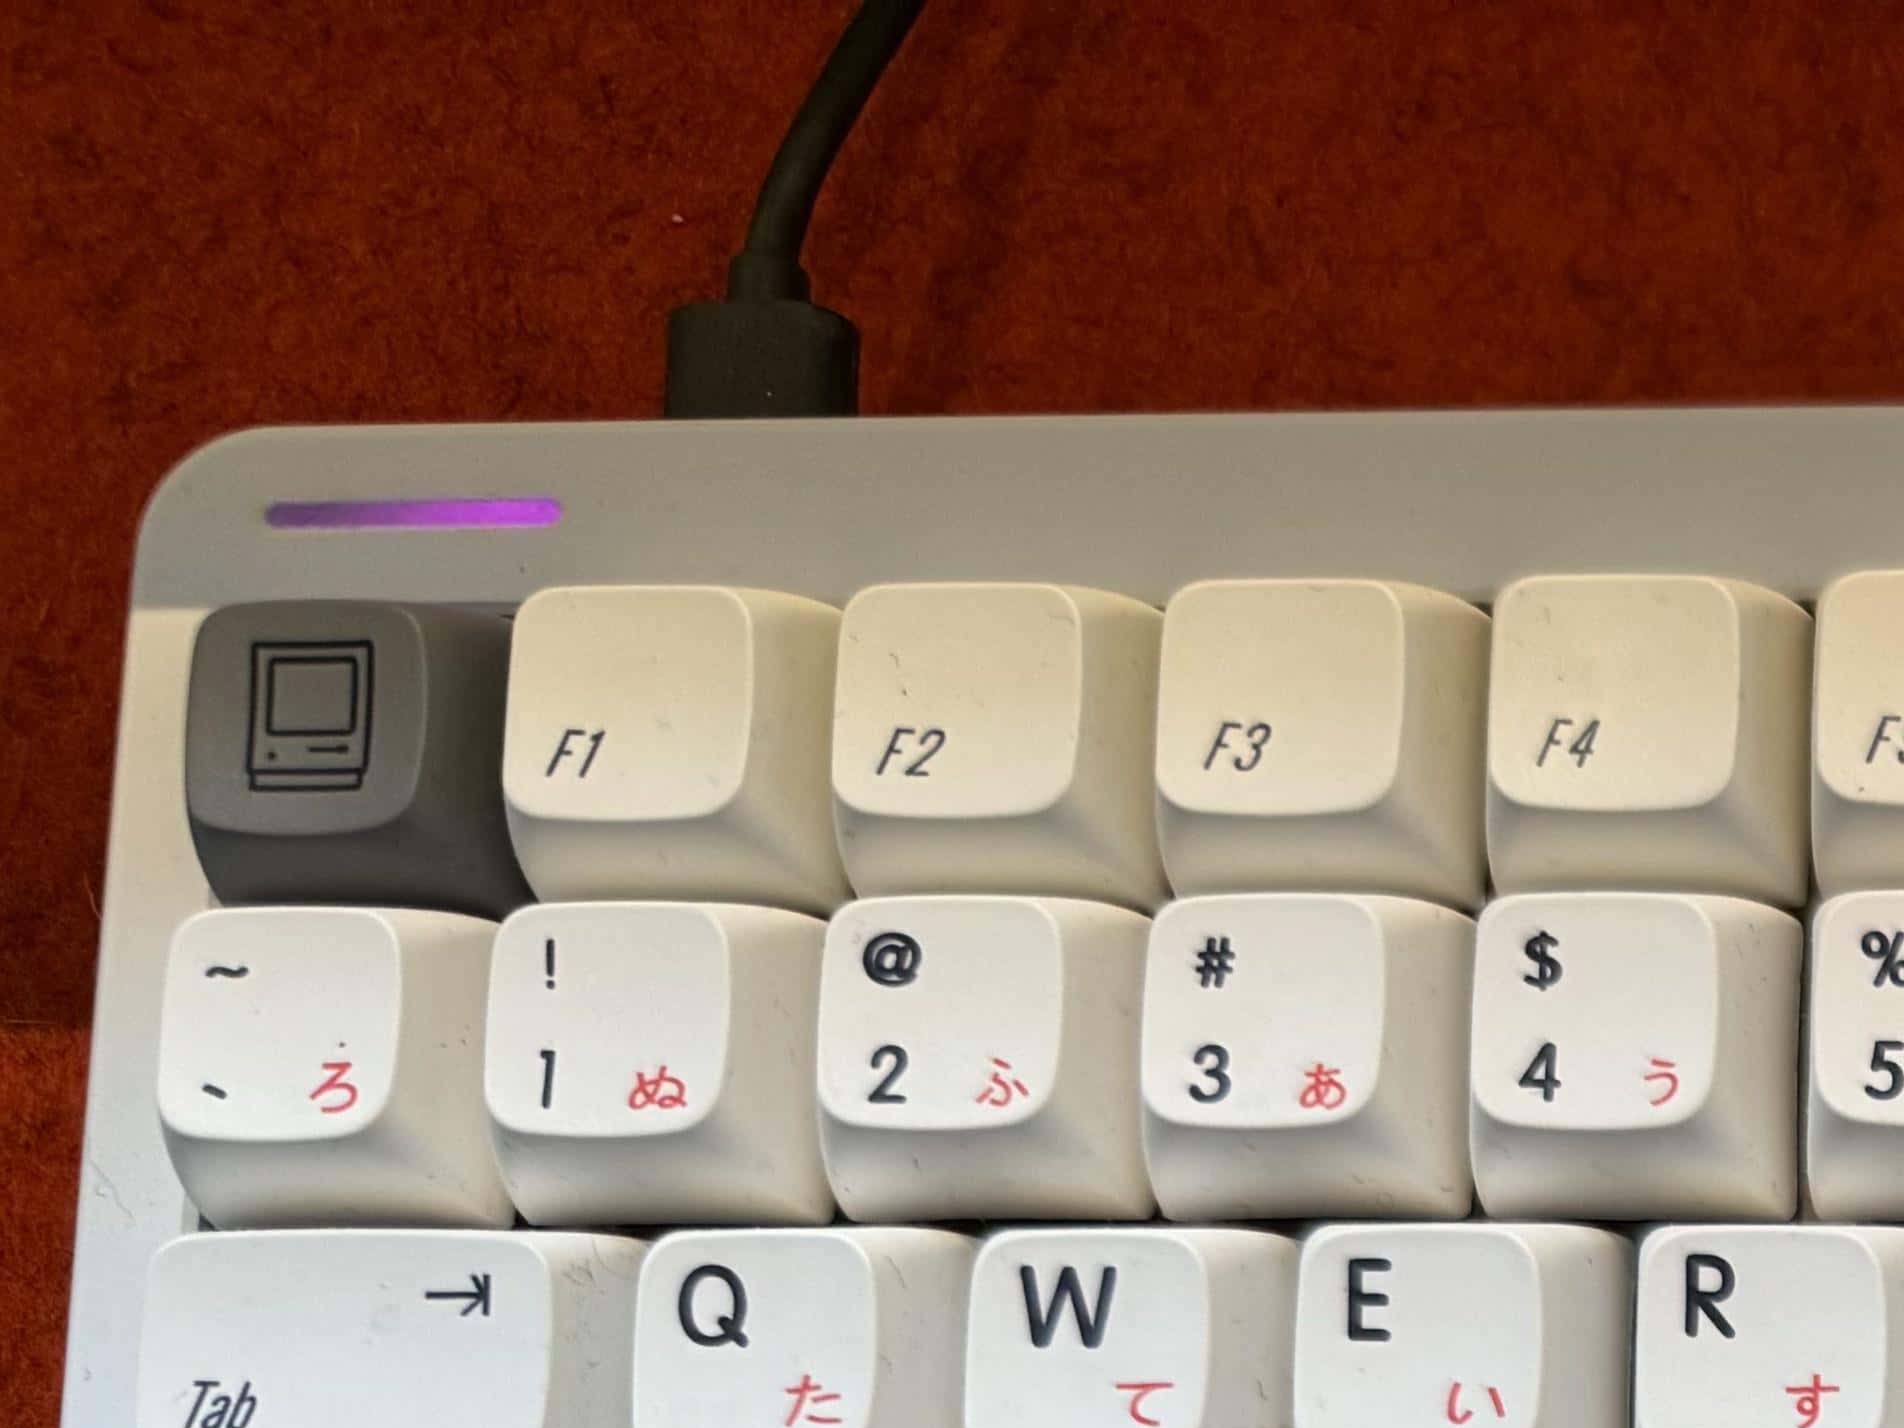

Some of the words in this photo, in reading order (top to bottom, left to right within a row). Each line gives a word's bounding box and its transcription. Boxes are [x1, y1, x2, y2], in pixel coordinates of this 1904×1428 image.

[544, 727, 607, 780] F1
[874, 726, 947, 778] F2
[1202, 720, 1273, 773] F3
[1535, 716, 1602, 770] F4
[544, 937, 557, 991] !
[860, 930, 923, 989] @
[1193, 935, 1236, 989] #
[1522, 929, 1564, 992] $
[308, 1059, 360, 1115] ろ
[538, 1048, 557, 1110] 1
[625, 1064, 688, 1111] ぬ
[866, 1043, 909, 1105] 2
[974, 1056, 1031, 1110] ふ
[1187, 1042, 1232, 1104] 3
[1297, 1062, 1349, 1110] あ
[1516, 1040, 1563, 1103] 4
[1642, 1054, 1681, 1109] う
[676, 1262, 749, 1349] Q
[1017, 1263, 1118, 1350] W
[1345, 1256, 1393, 1343] E
[1683, 1251, 1737, 1340] R
[783, 1373, 842, 1427] た
[1114, 1379, 1173, 1428] て
[1443, 1380, 1506, 1426] い
